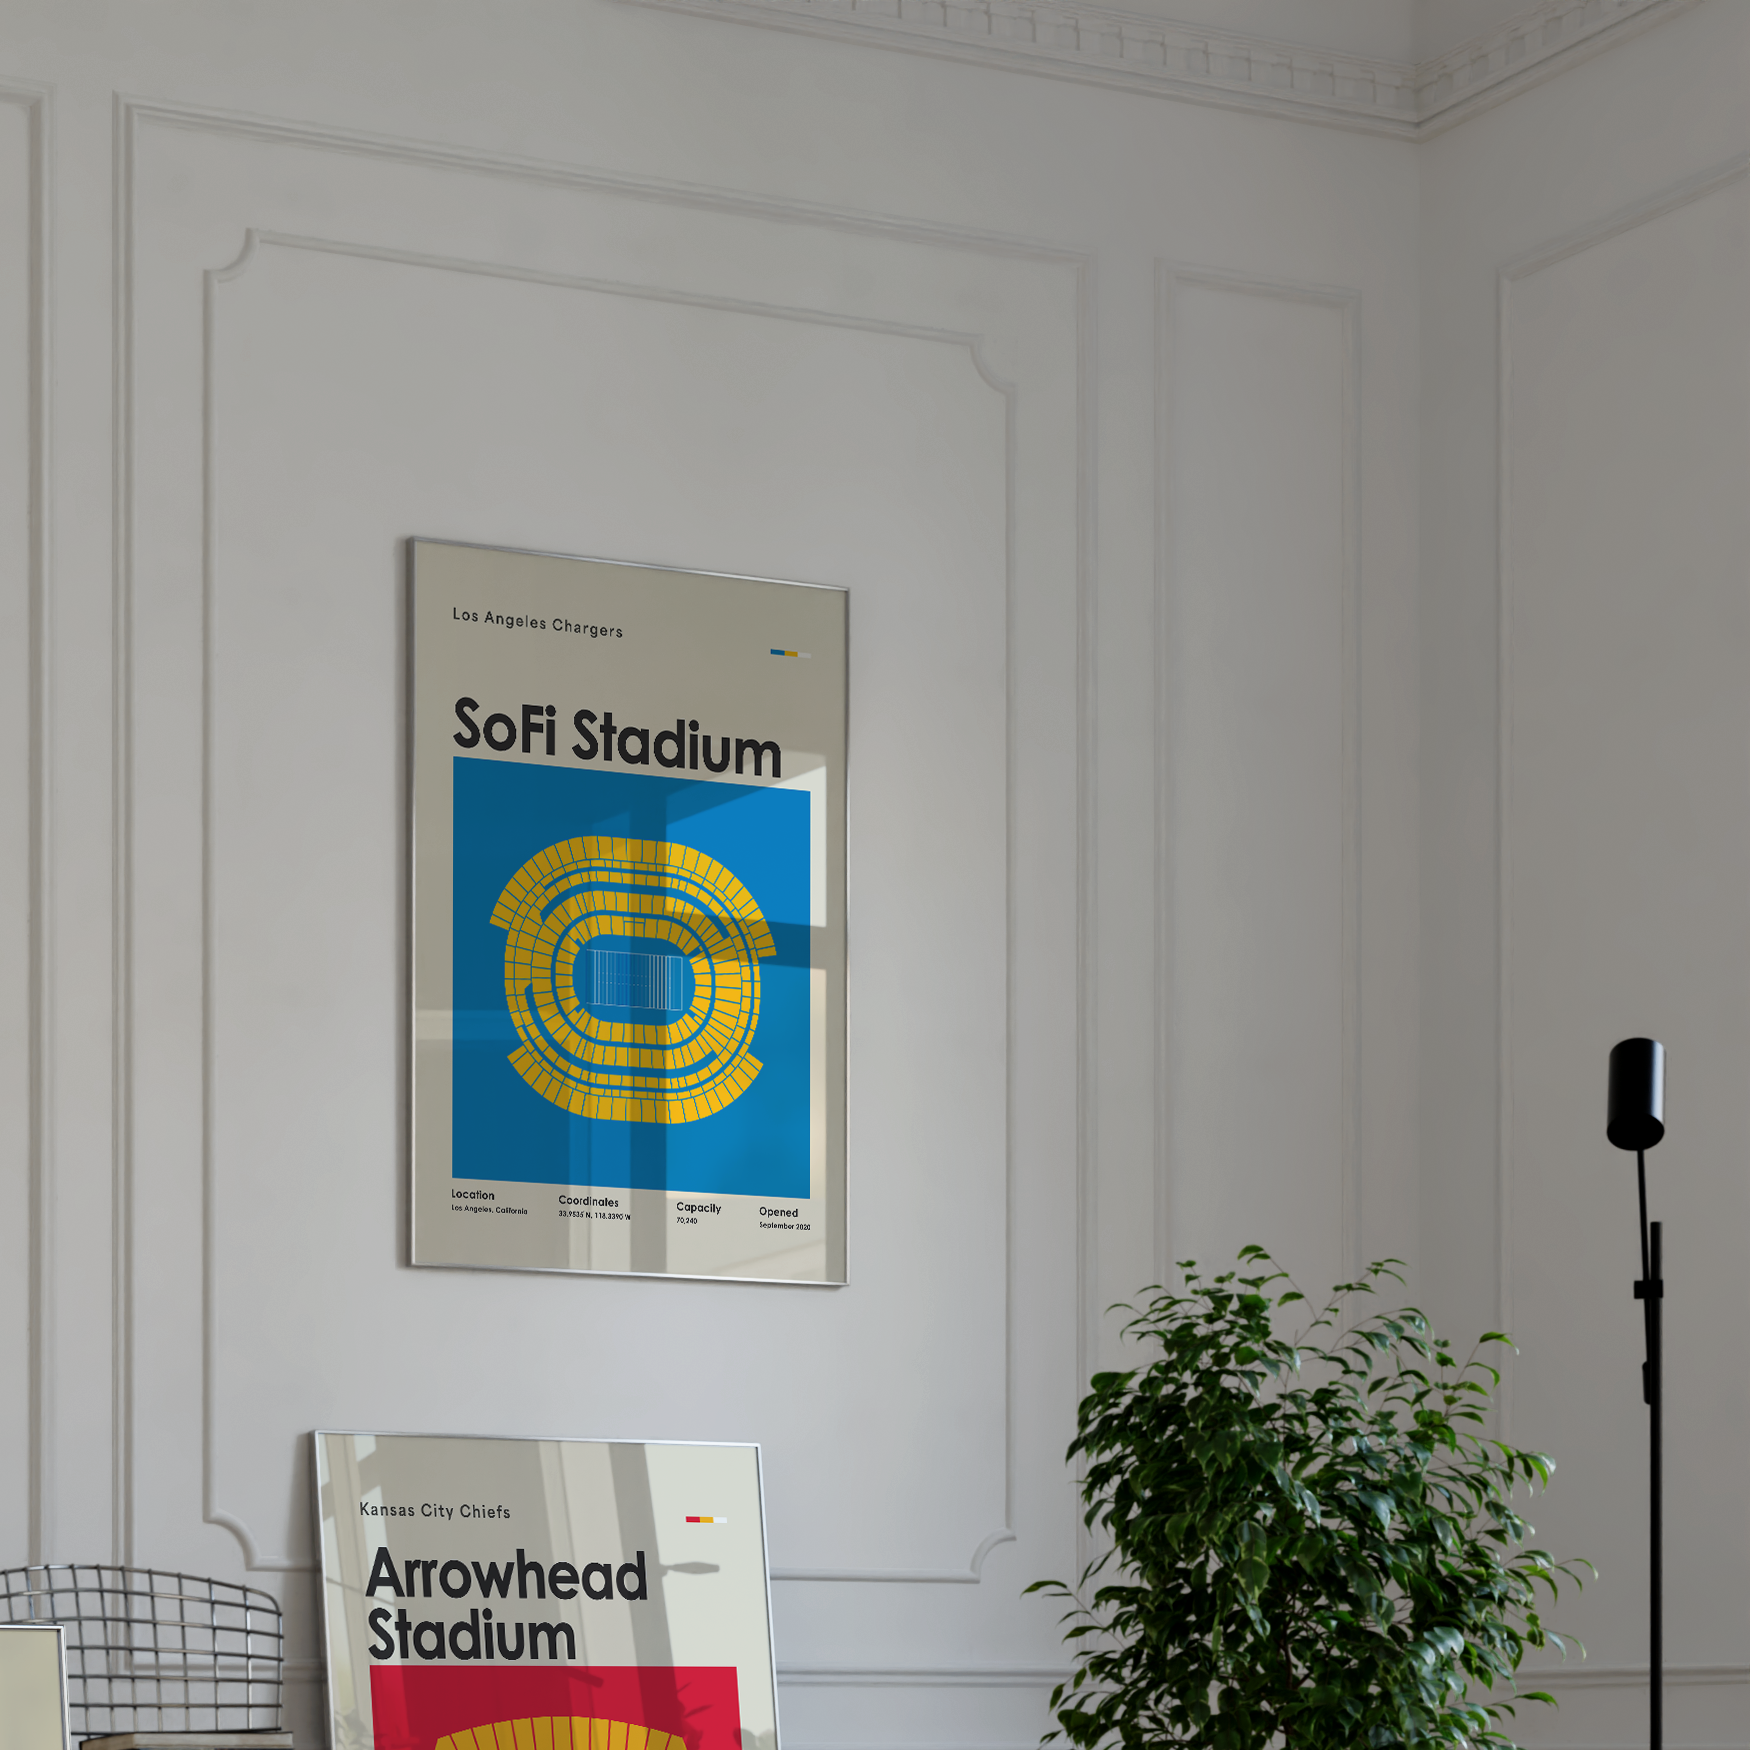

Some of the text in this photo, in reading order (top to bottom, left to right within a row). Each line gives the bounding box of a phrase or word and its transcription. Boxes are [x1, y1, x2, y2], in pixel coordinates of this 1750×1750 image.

[453, 607, 623, 639] Los Angeles Chargers
[452, 696, 782, 778] SoFi Stadium
[451, 1189, 495, 1201] Location
[558, 1194, 619, 1207] Coordinates
[451, 1204, 528, 1215] Los Angeles, California
[676, 1201, 722, 1215] Capacity
[759, 1206, 799, 1218] Opened
[759, 1221, 811, 1231] September 2020
[359, 1501, 511, 1521] Kansas City Chiefs
[365, 1546, 648, 1601] Arrowhead
[368, 1607, 576, 1661] Stadium
